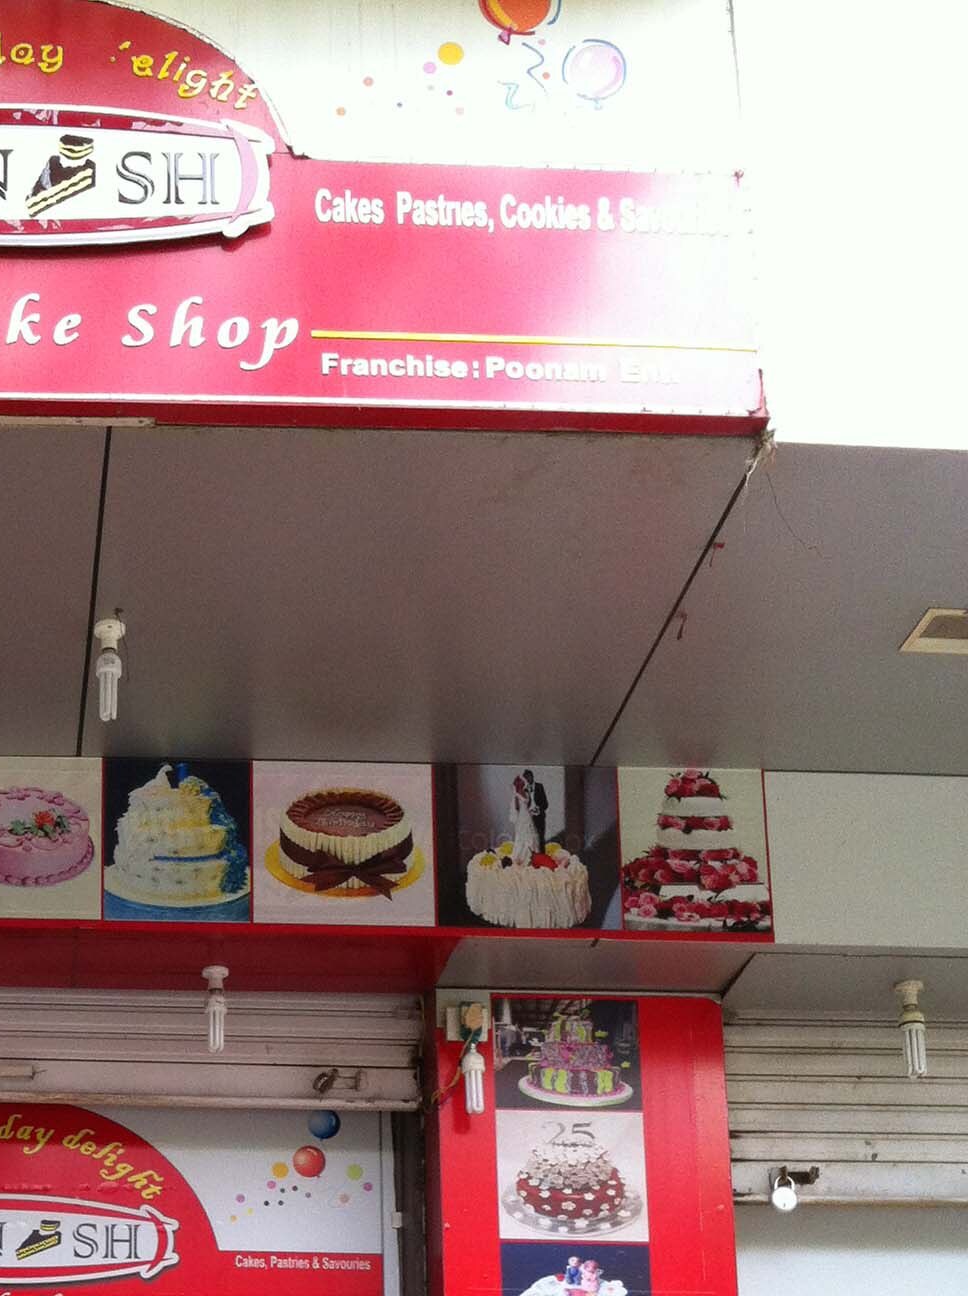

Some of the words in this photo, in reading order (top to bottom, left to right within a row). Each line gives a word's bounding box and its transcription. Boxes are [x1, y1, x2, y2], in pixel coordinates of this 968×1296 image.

[109, 41, 261, 110] elight
[500, 193, 592, 232] Cookies
[597, 196, 616, 231] &
[122, 296, 301, 370] Shop
[62, 1128, 166, 1200] delight
[234, 1254, 268, 1272] Cakes,
[270, 1255, 311, 1272] Pastries
[311, 1256, 321, 1271] &
[322, 1257, 372, 1273] Savouries
